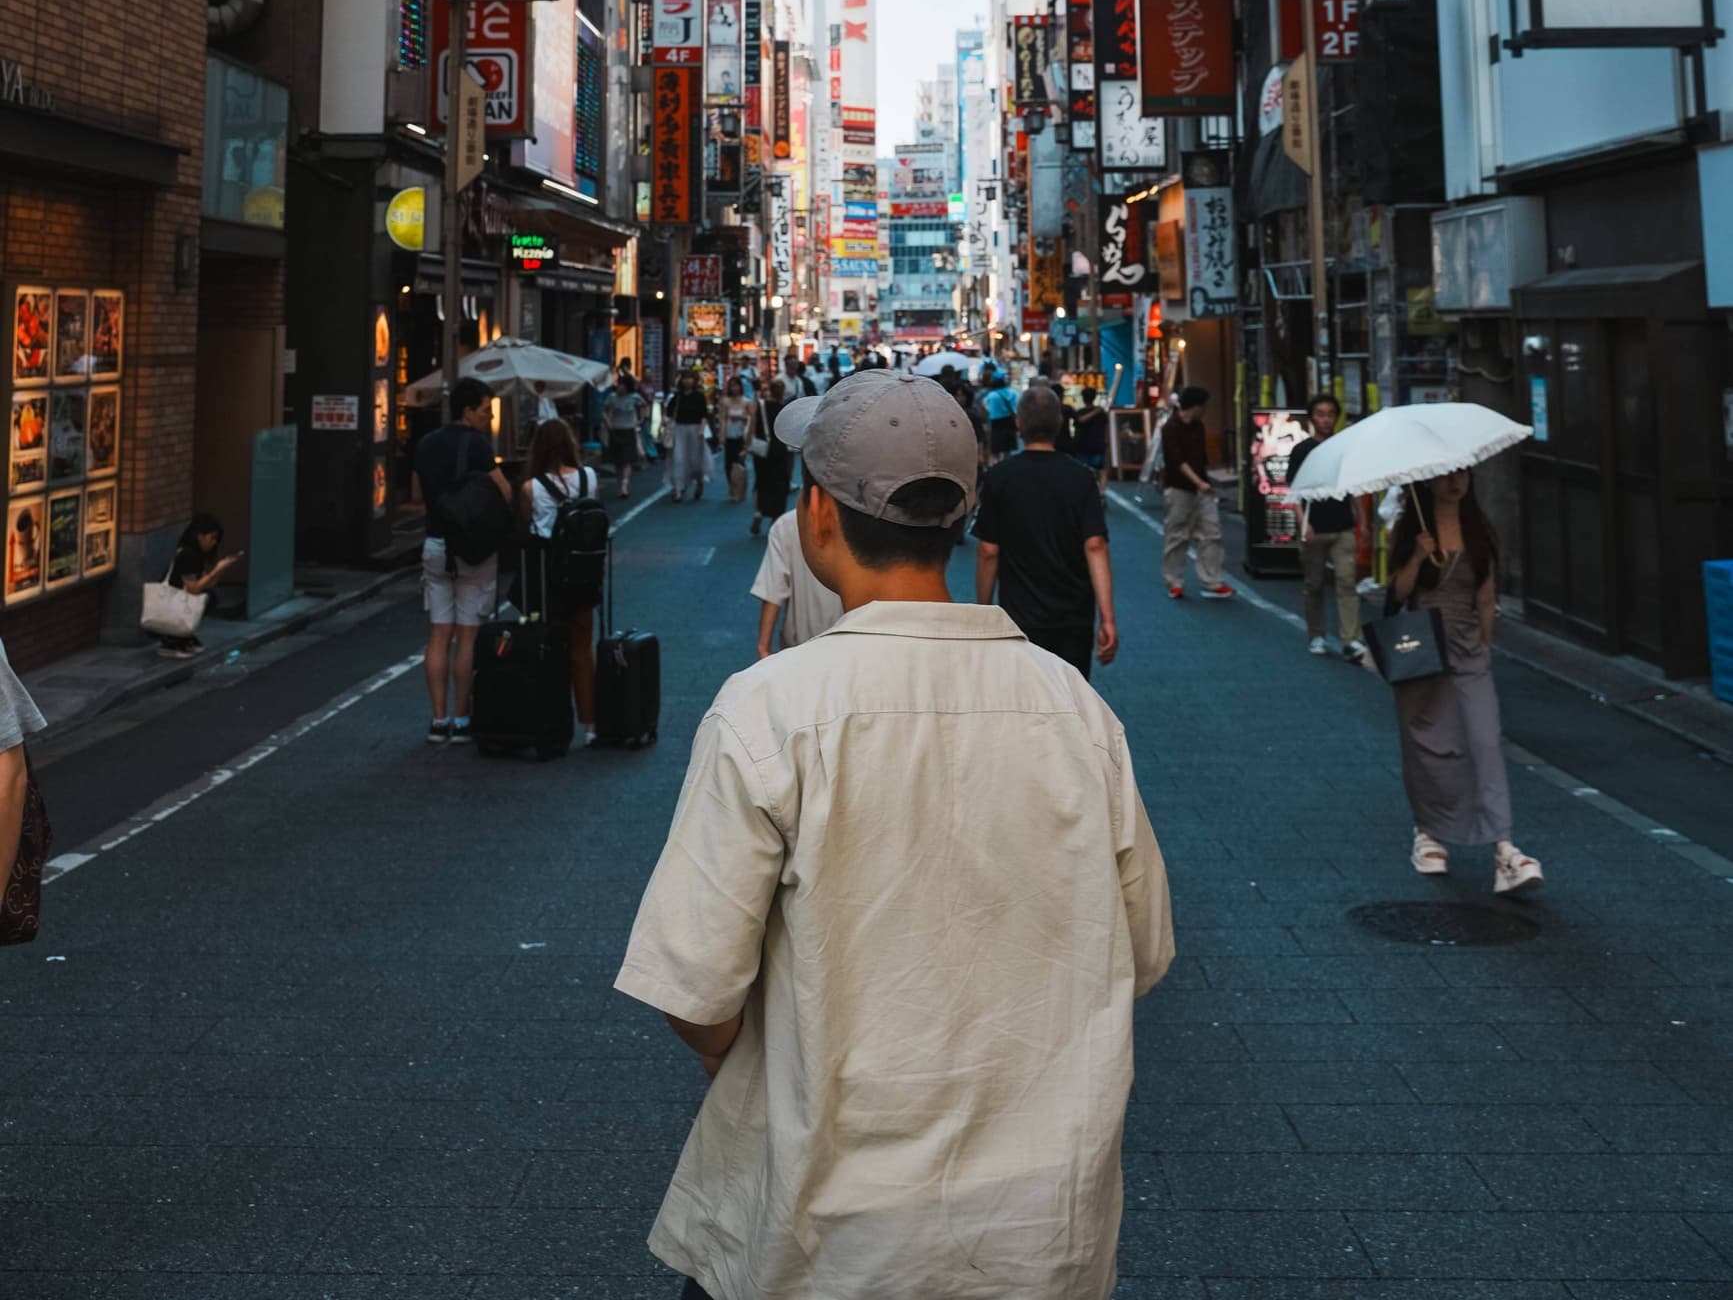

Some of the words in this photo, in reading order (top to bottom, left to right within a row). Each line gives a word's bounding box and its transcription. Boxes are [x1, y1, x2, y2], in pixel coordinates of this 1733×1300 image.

[1323, 1, 1358, 22] 1F
[1322, 33, 1358, 55] 2F
[665, 49, 691, 63] 4F
